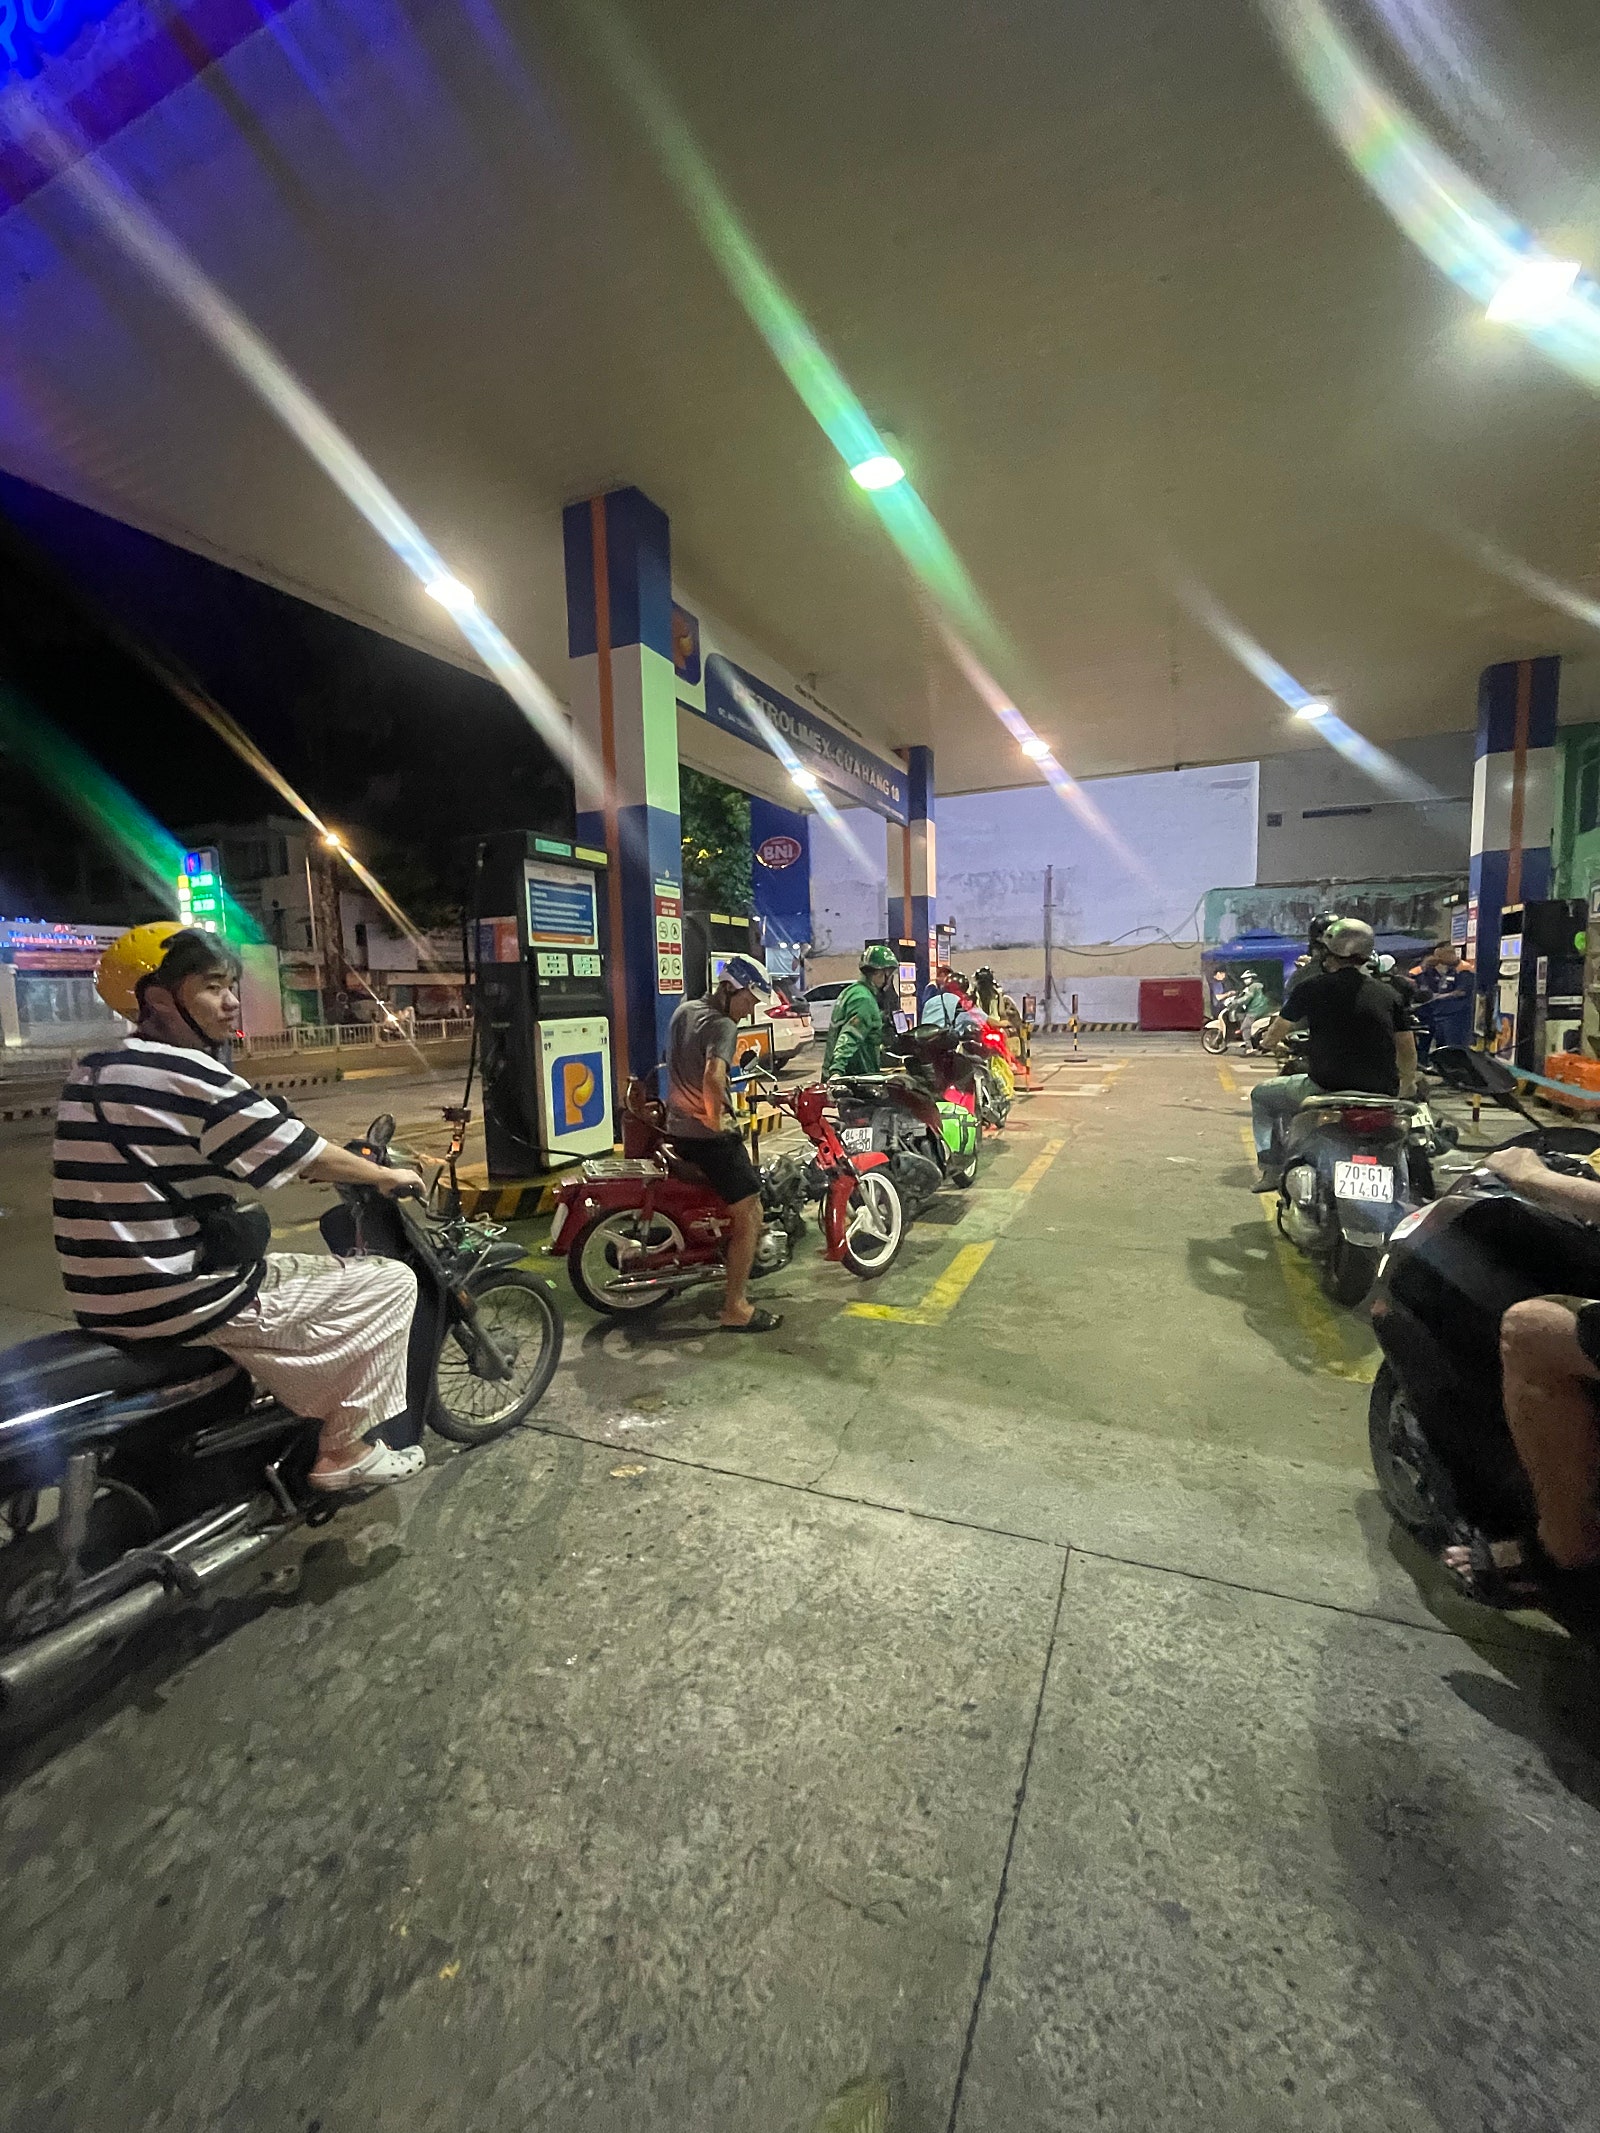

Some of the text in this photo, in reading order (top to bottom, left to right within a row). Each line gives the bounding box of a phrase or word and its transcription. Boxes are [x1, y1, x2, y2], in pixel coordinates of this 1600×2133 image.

[763, 843, 793, 860] BNI
[1345, 1165, 1382, 1183] 70-G1
[1339, 1180, 1389, 1200] 214.04
